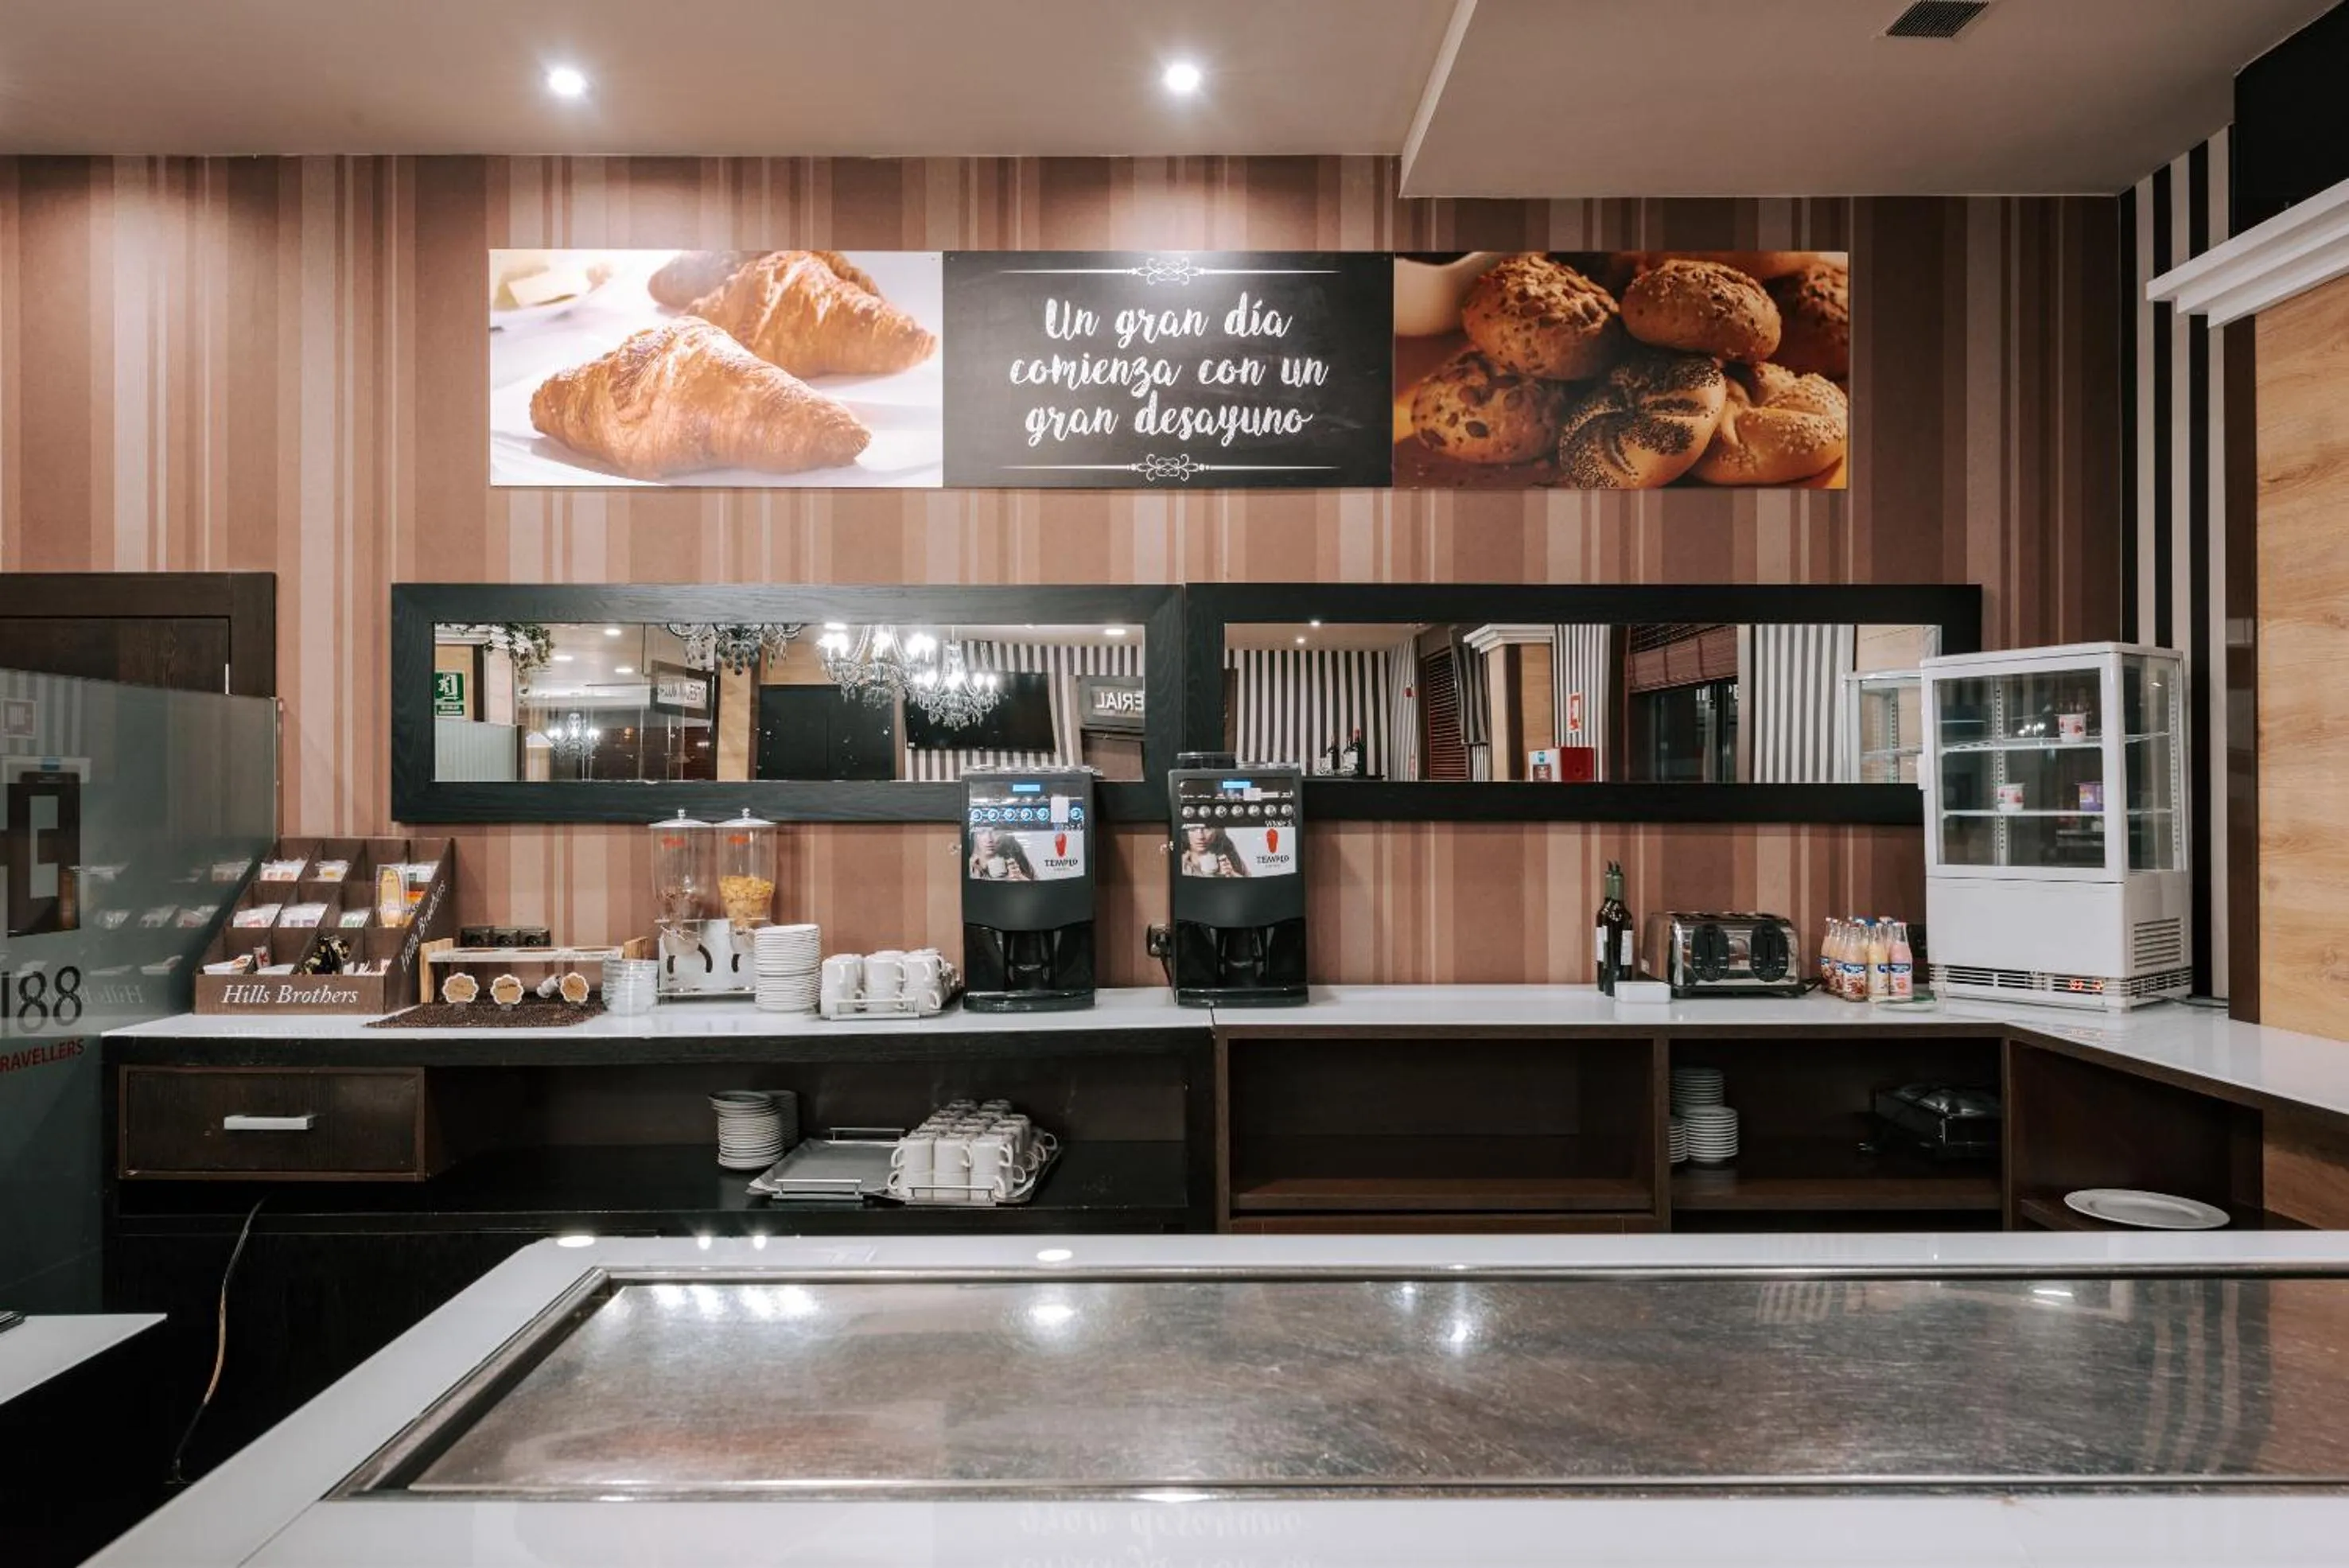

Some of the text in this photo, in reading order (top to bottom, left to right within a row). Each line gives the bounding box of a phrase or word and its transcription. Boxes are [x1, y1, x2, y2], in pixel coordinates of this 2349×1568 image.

[1044, 291, 1293, 348] Un gran día
[1009, 352, 1329, 398] comienza con un
[1025, 390, 1314, 447] gran desayuno
[221, 984, 359, 1004] Hills Brothers
